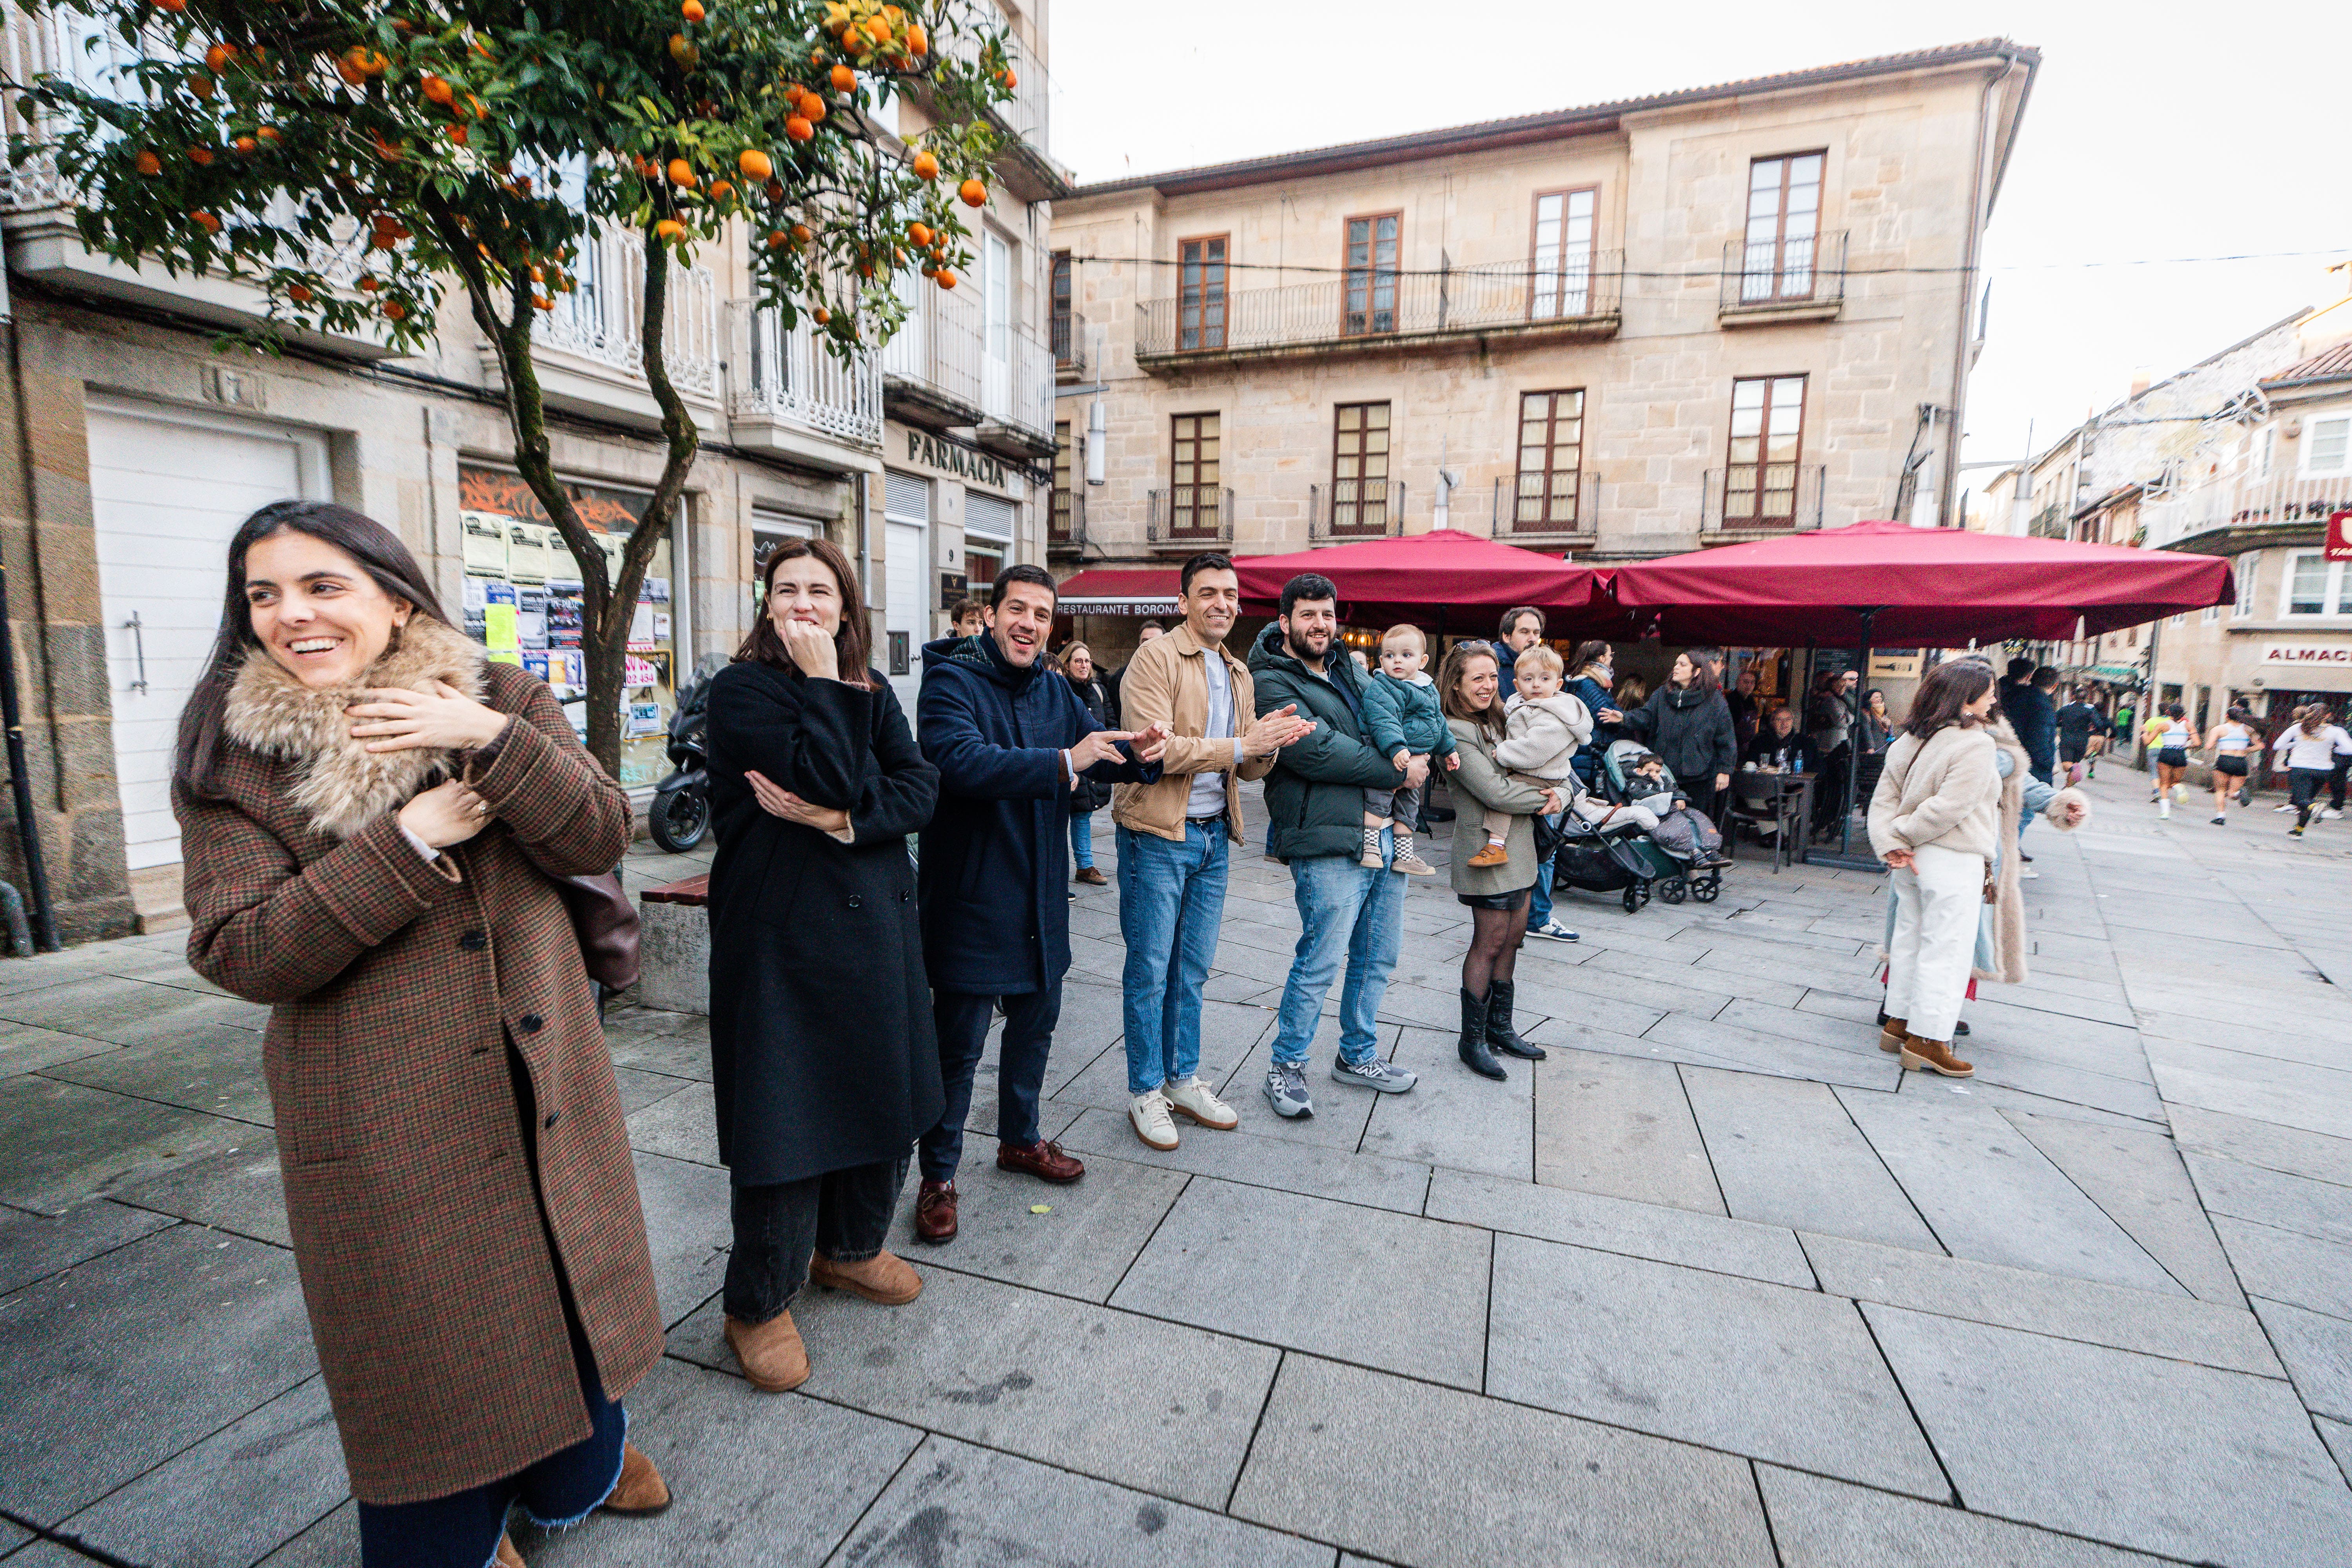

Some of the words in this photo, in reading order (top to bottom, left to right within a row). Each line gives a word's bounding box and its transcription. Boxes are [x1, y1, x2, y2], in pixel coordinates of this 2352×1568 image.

[907, 430, 1005, 488] FARMACIA
[949, 548, 954, 562] 9
[1057, 604, 1129, 614] RESTAURANTE
[2267, 648, 2352, 661] ALMAC
[640, 673, 654, 683] 454
